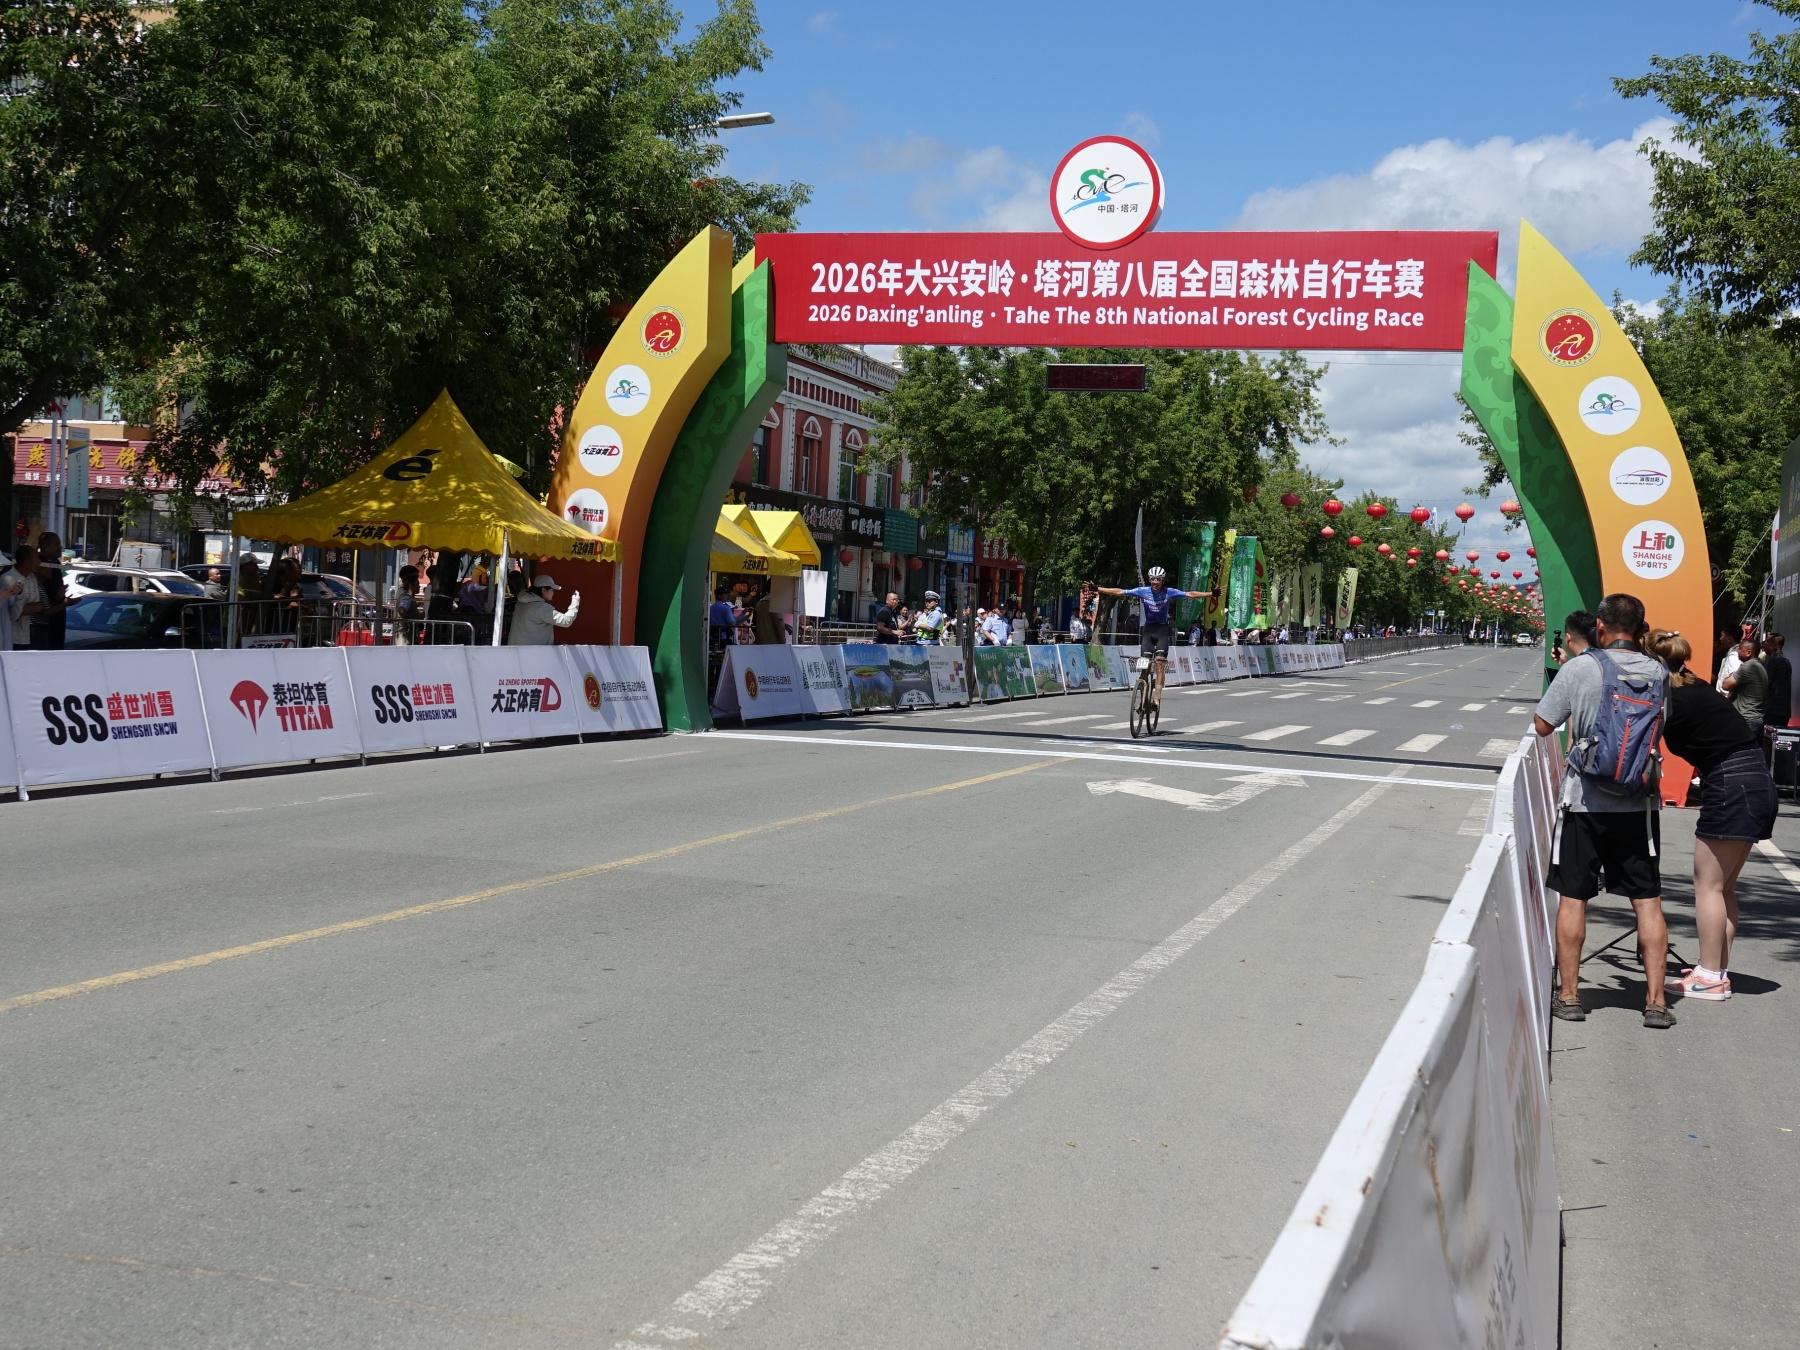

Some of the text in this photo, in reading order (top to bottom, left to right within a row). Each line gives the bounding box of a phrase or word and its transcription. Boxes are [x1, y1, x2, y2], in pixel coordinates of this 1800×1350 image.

[1097, 204, 1138, 213] 中国·塔河
[811, 259, 1425, 299] 2026年大兴安岭·塔河第八届全国森林自行车赛
[808, 303, 1425, 331] 2026 Daxing'anling Tahe The 8th National Forest Cycling Race
[582, 514, 604, 523] TITAN
[332, 523, 391, 540] 大正体育
[1632, 530, 1675, 551] 上和
[570, 541, 595, 556] 大正体育
[1632, 551, 1673, 561] SHANGHE
[1635, 560, 1668, 570] SPORTS
[272, 681, 329, 707] 泰坦体育
[371, 683, 414, 725] SSS
[411, 682, 455, 706] 盛世冰雪
[491, 688, 543, 714] 大正体育
[106, 690, 175, 721] 盛世冰雪
[415, 708, 458, 722] SHENGSHI SNOW
[41, 693, 110, 746] SSS
[275, 704, 335, 732] TITAN
[111, 721, 179, 740] SHENGSHI SNOW
